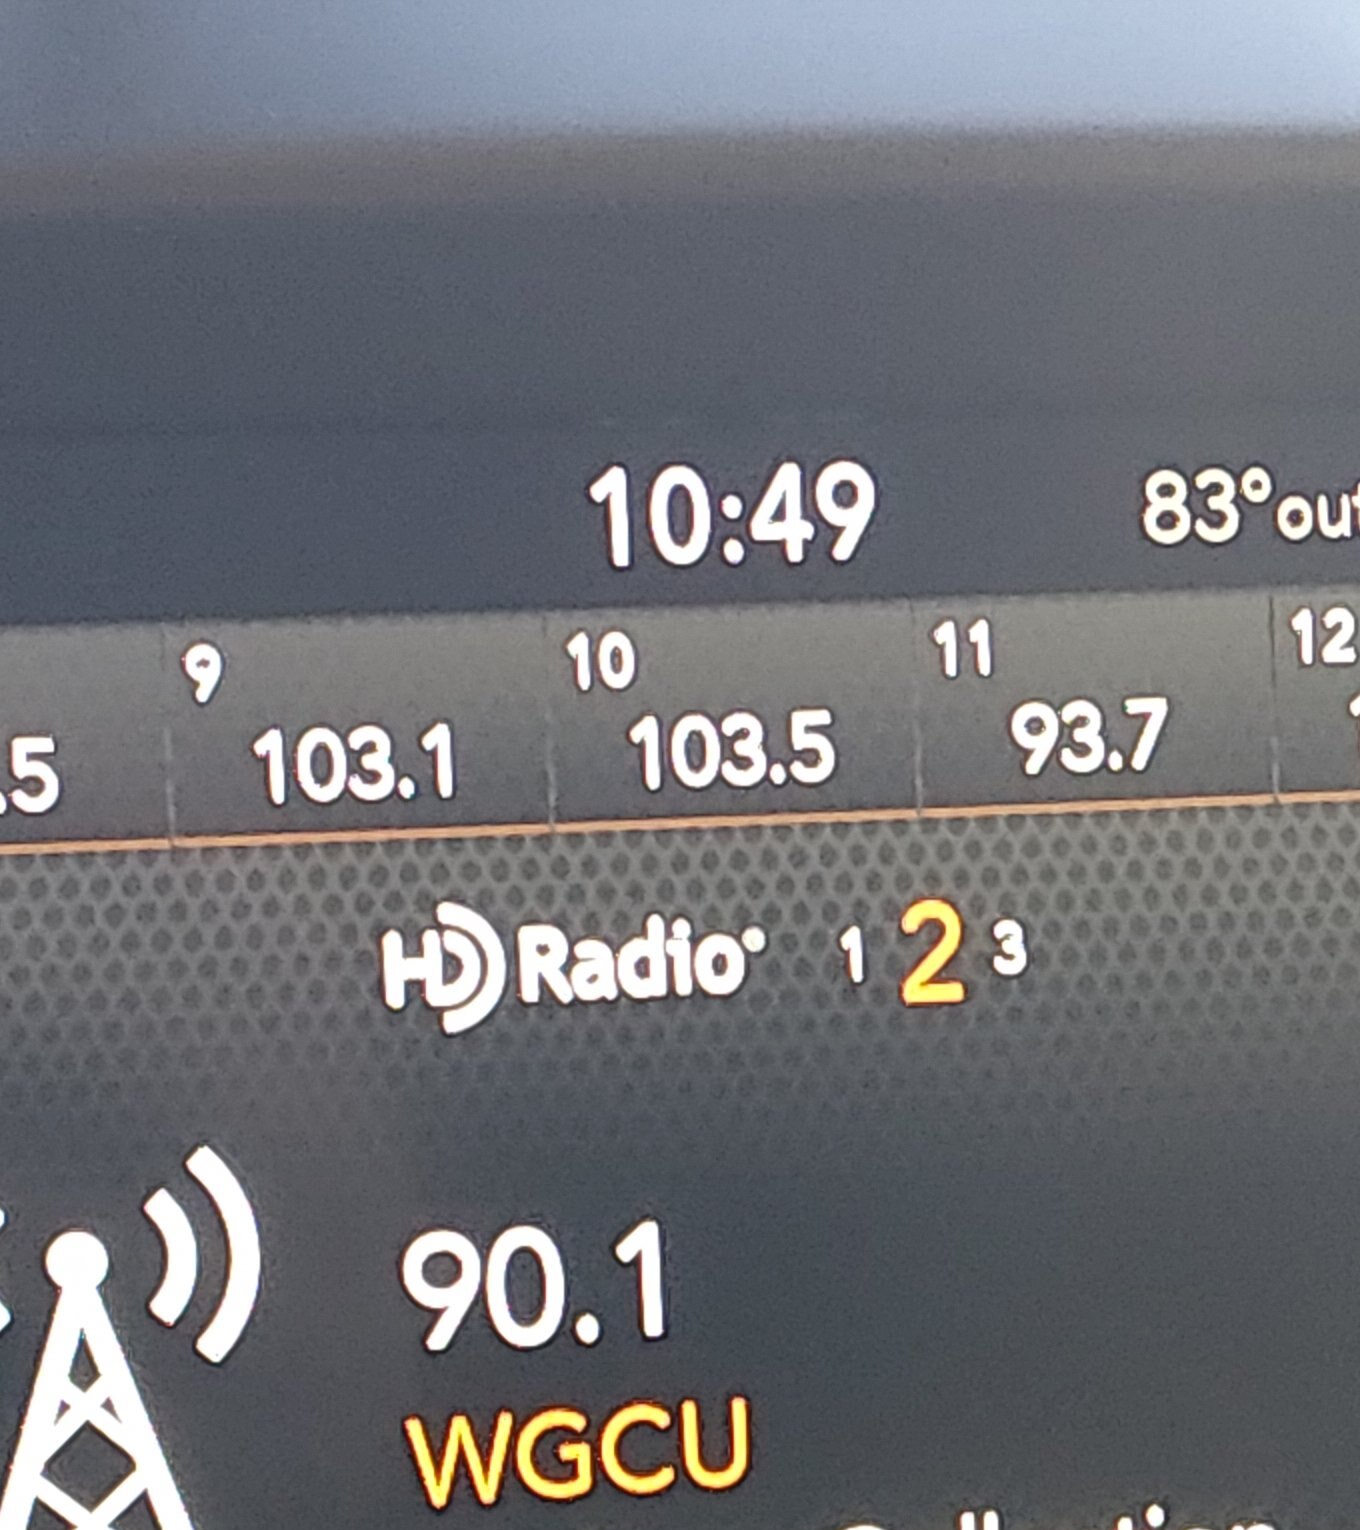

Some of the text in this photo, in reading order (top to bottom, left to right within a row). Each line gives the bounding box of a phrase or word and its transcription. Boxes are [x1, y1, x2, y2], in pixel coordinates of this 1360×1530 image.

[589, 460, 875, 567] 10:49
[181, 643, 222, 703] 9
[566, 631, 635, 691] 10
[933, 619, 991, 677] 11
[1291, 607, 1357, 665] 12
[253, 722, 453, 805] 103.1
[629, 709, 835, 790] 103.5
[1011, 697, 1168, 775] 93.7
[840, 899, 1027, 1005] 1 2 3
[402, 1220, 664, 1351] 90.1
[404, 1396, 748, 1509] WGCU
